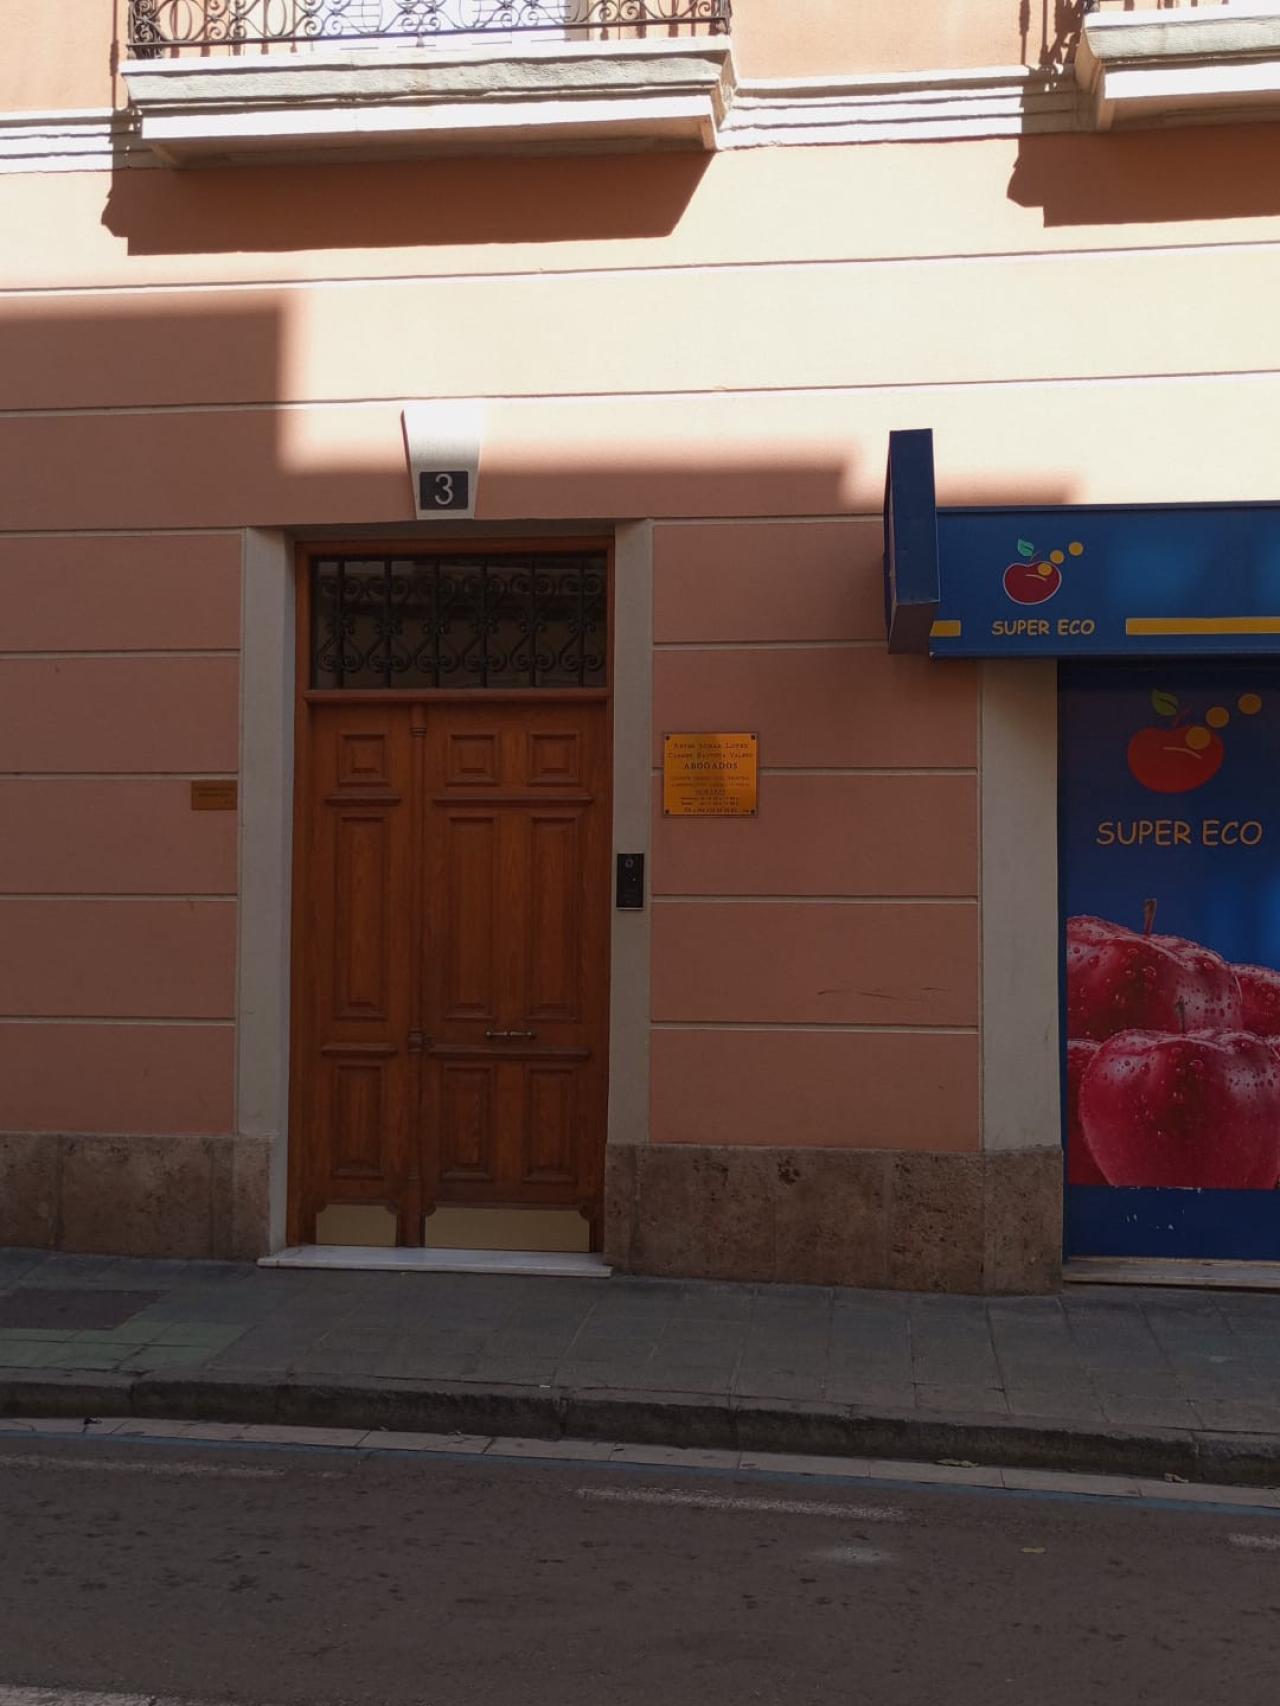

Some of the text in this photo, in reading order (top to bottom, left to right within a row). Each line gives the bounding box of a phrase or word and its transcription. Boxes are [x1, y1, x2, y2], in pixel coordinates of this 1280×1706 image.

[434, 473, 453, 505] 3
[991, 618, 1095, 636] SUPER ECO
[1096, 820, 1263, 846] SUPER ECO
